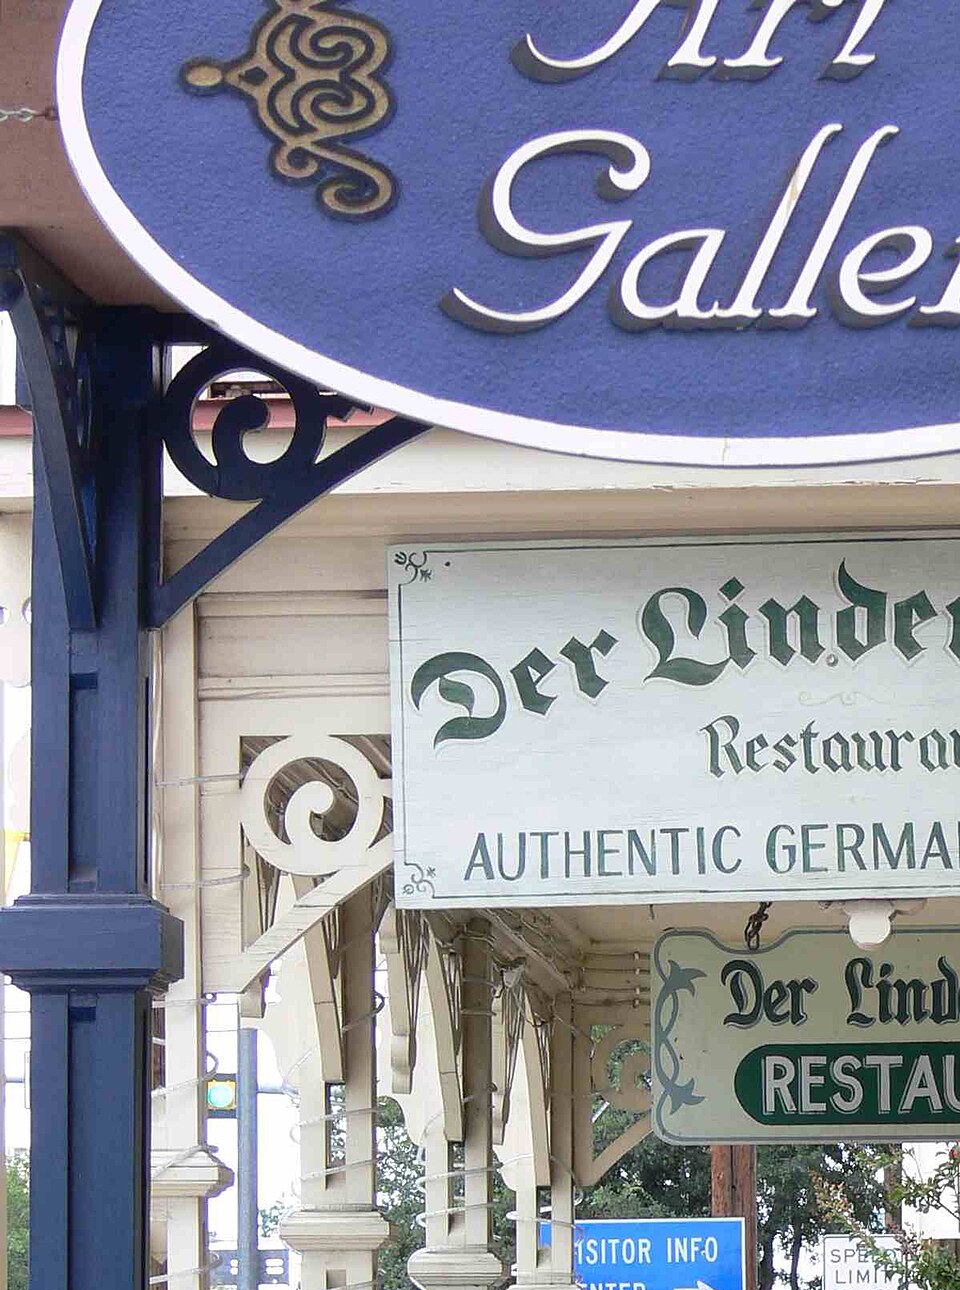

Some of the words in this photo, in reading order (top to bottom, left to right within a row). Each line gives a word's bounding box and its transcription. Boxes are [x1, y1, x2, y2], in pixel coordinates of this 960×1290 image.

[411, 629, 619, 749] Der
[464, 825, 742, 881] AUTHENTIC
[721, 959, 818, 1027] Der
[576, 1237, 651, 1265] ISITOR
[667, 1236, 718, 1263] INFO
